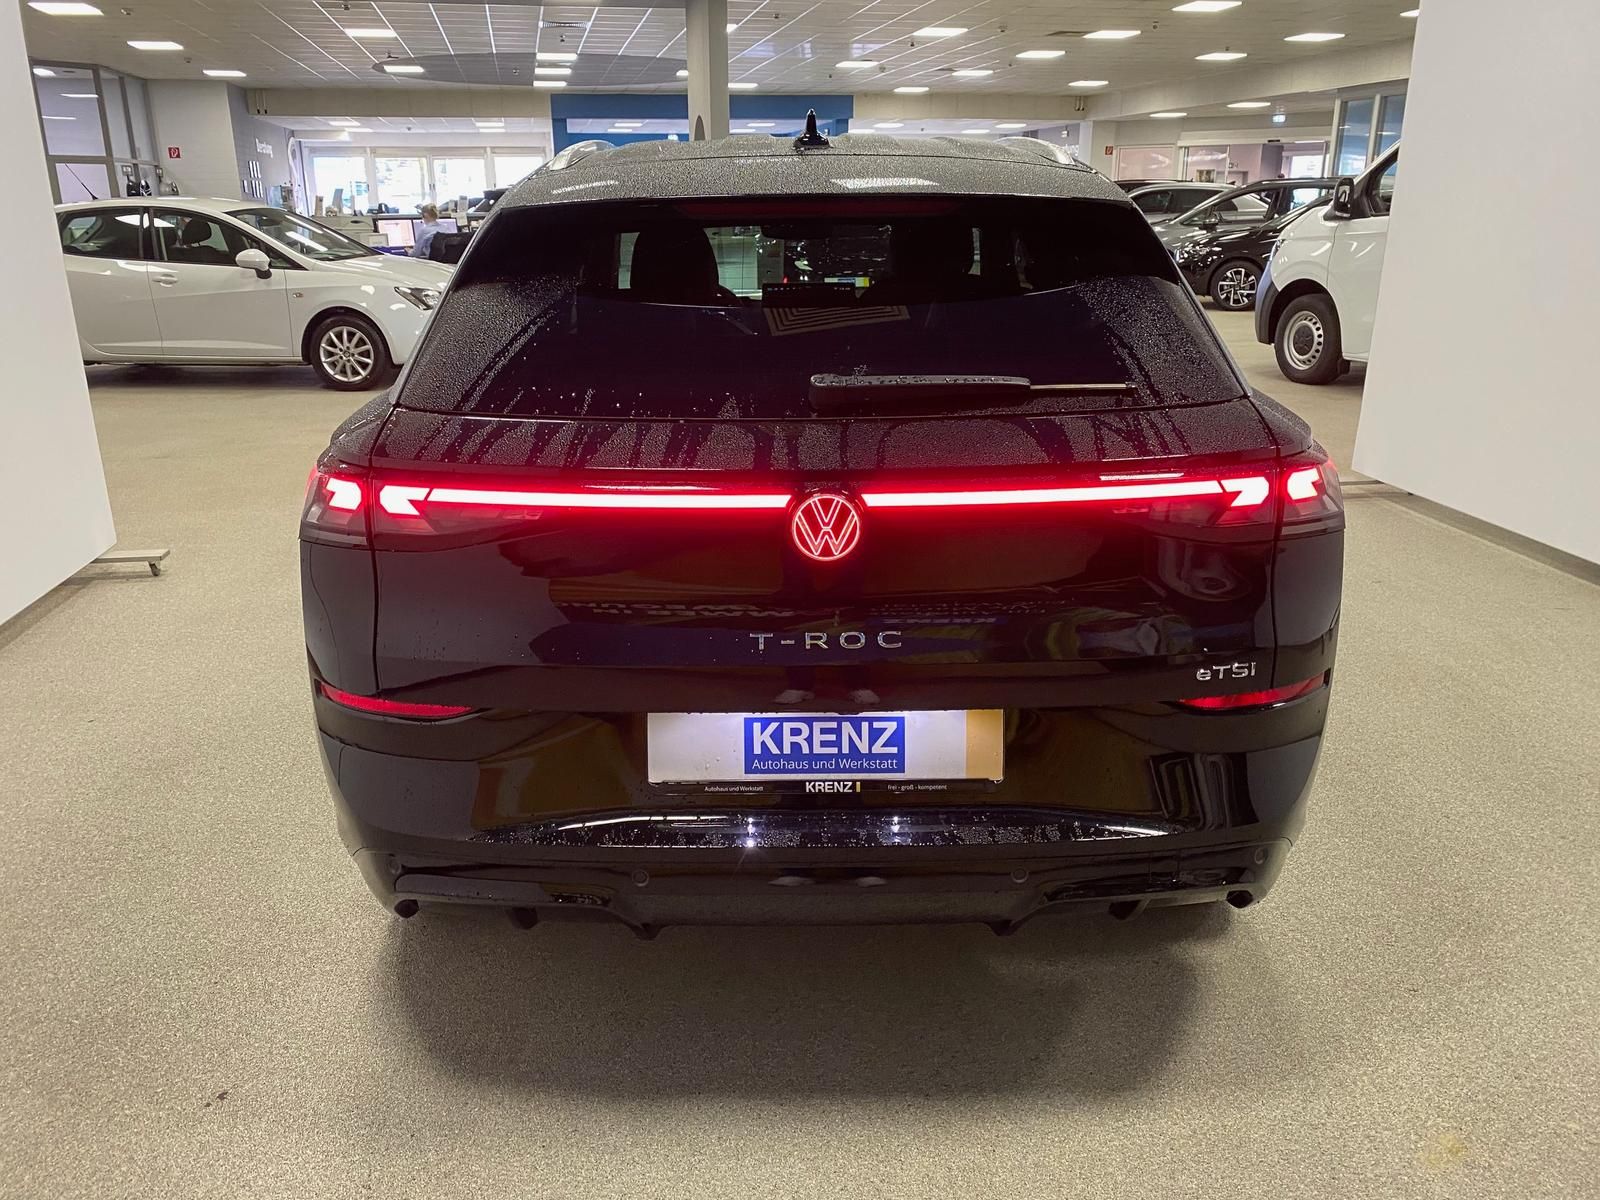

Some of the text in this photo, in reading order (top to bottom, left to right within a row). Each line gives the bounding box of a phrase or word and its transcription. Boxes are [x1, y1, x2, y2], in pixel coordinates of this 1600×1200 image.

[749, 631, 902, 650] T-ROC
[752, 721, 899, 755] KRENZ
[752, 758, 898, 770] Autohaus und Werkstatt
[805, 781, 853, 793] KRENZ
[917, 784, 947, 792] kompetent
